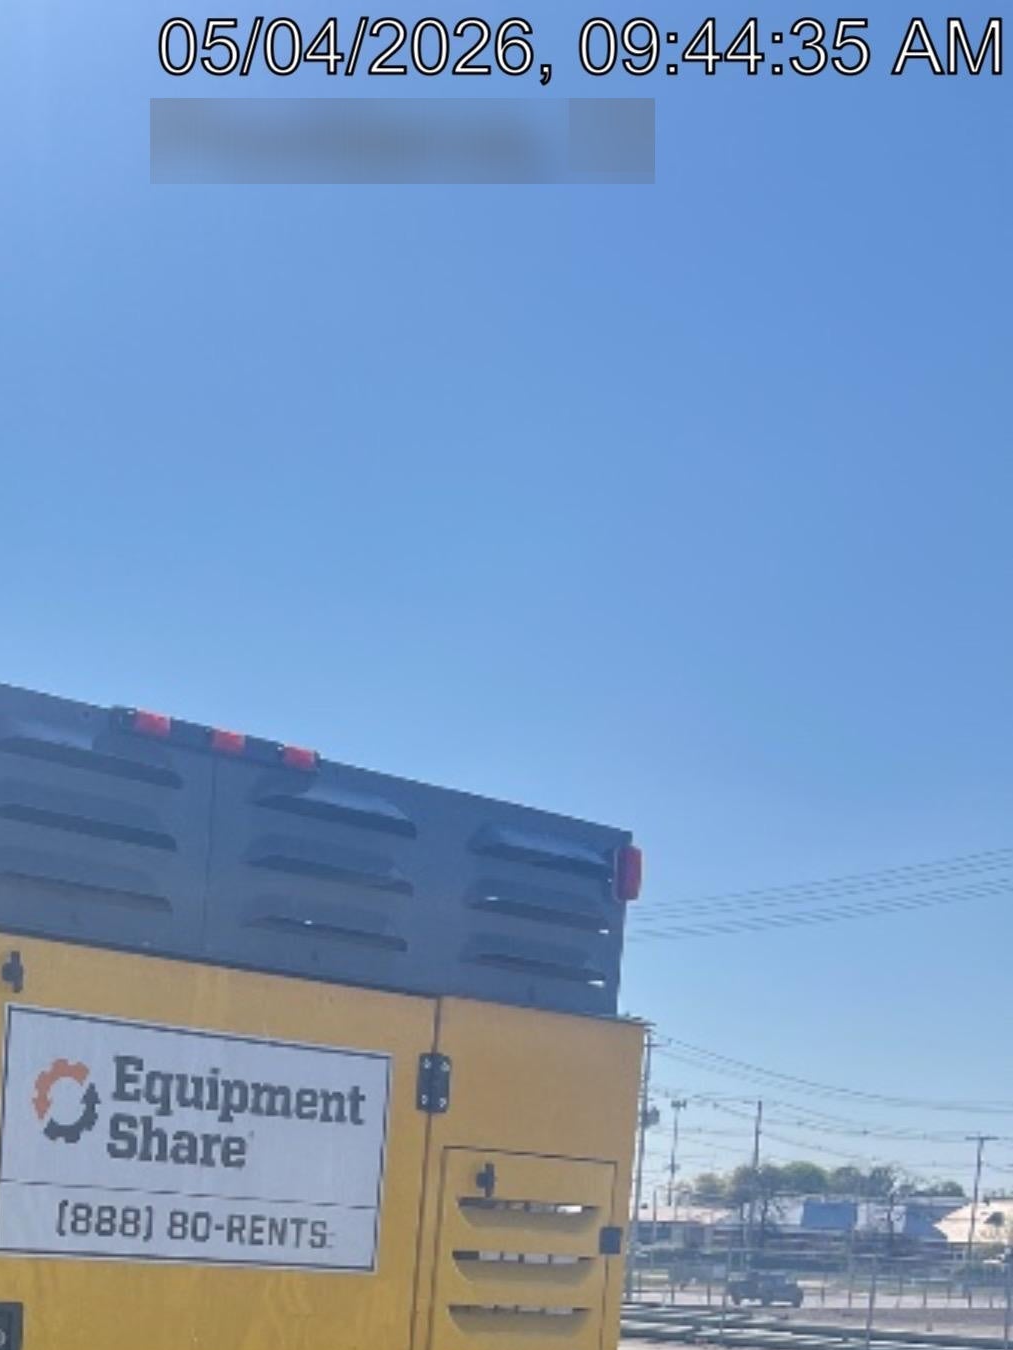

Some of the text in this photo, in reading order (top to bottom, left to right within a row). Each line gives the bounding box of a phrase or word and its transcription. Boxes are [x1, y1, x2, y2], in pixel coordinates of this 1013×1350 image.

[111, 1054, 366, 1126] Equipment
[105, 1112, 248, 1168] Share
[54, 1200, 329, 1250] (888) 80-RENTS
